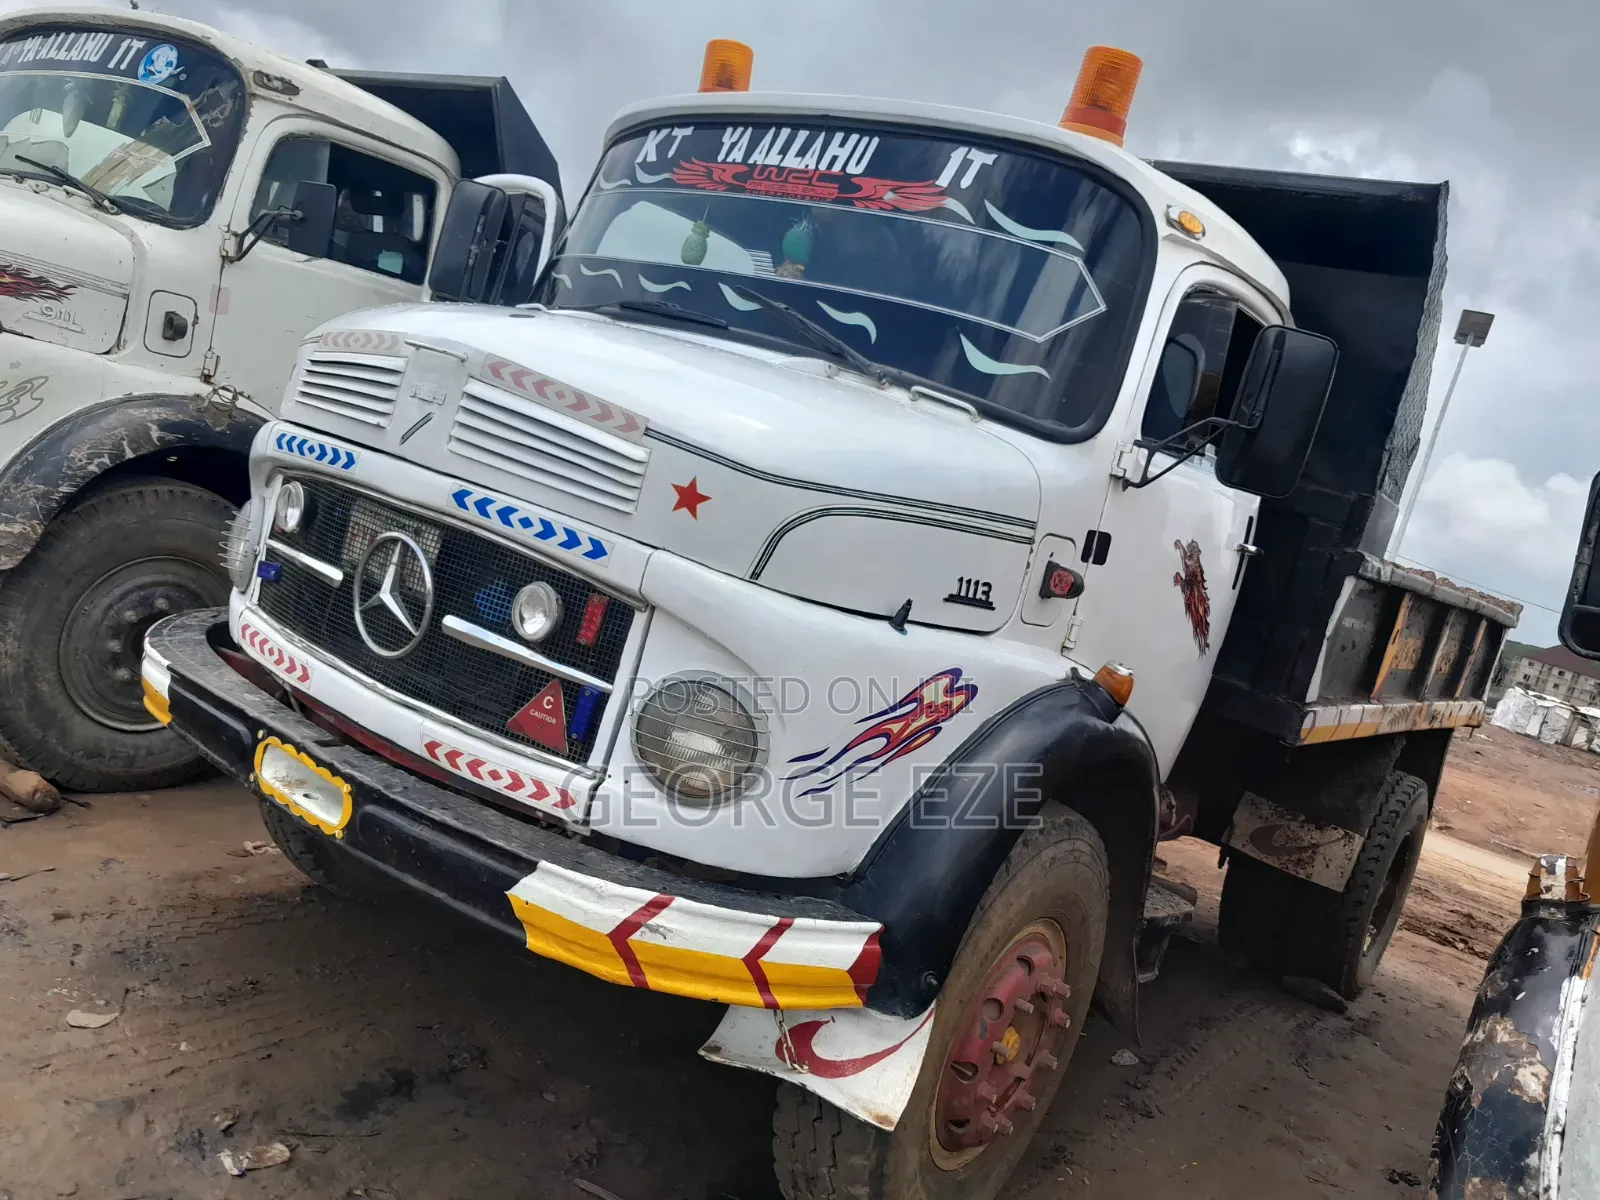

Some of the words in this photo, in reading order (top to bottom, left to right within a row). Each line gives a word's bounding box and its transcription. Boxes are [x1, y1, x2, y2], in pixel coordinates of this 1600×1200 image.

[635, 125, 695, 164] KT
[957, 576, 993, 601] 1113
[543, 695, 554, 710] C
[529, 708, 557, 725] CAUTION
